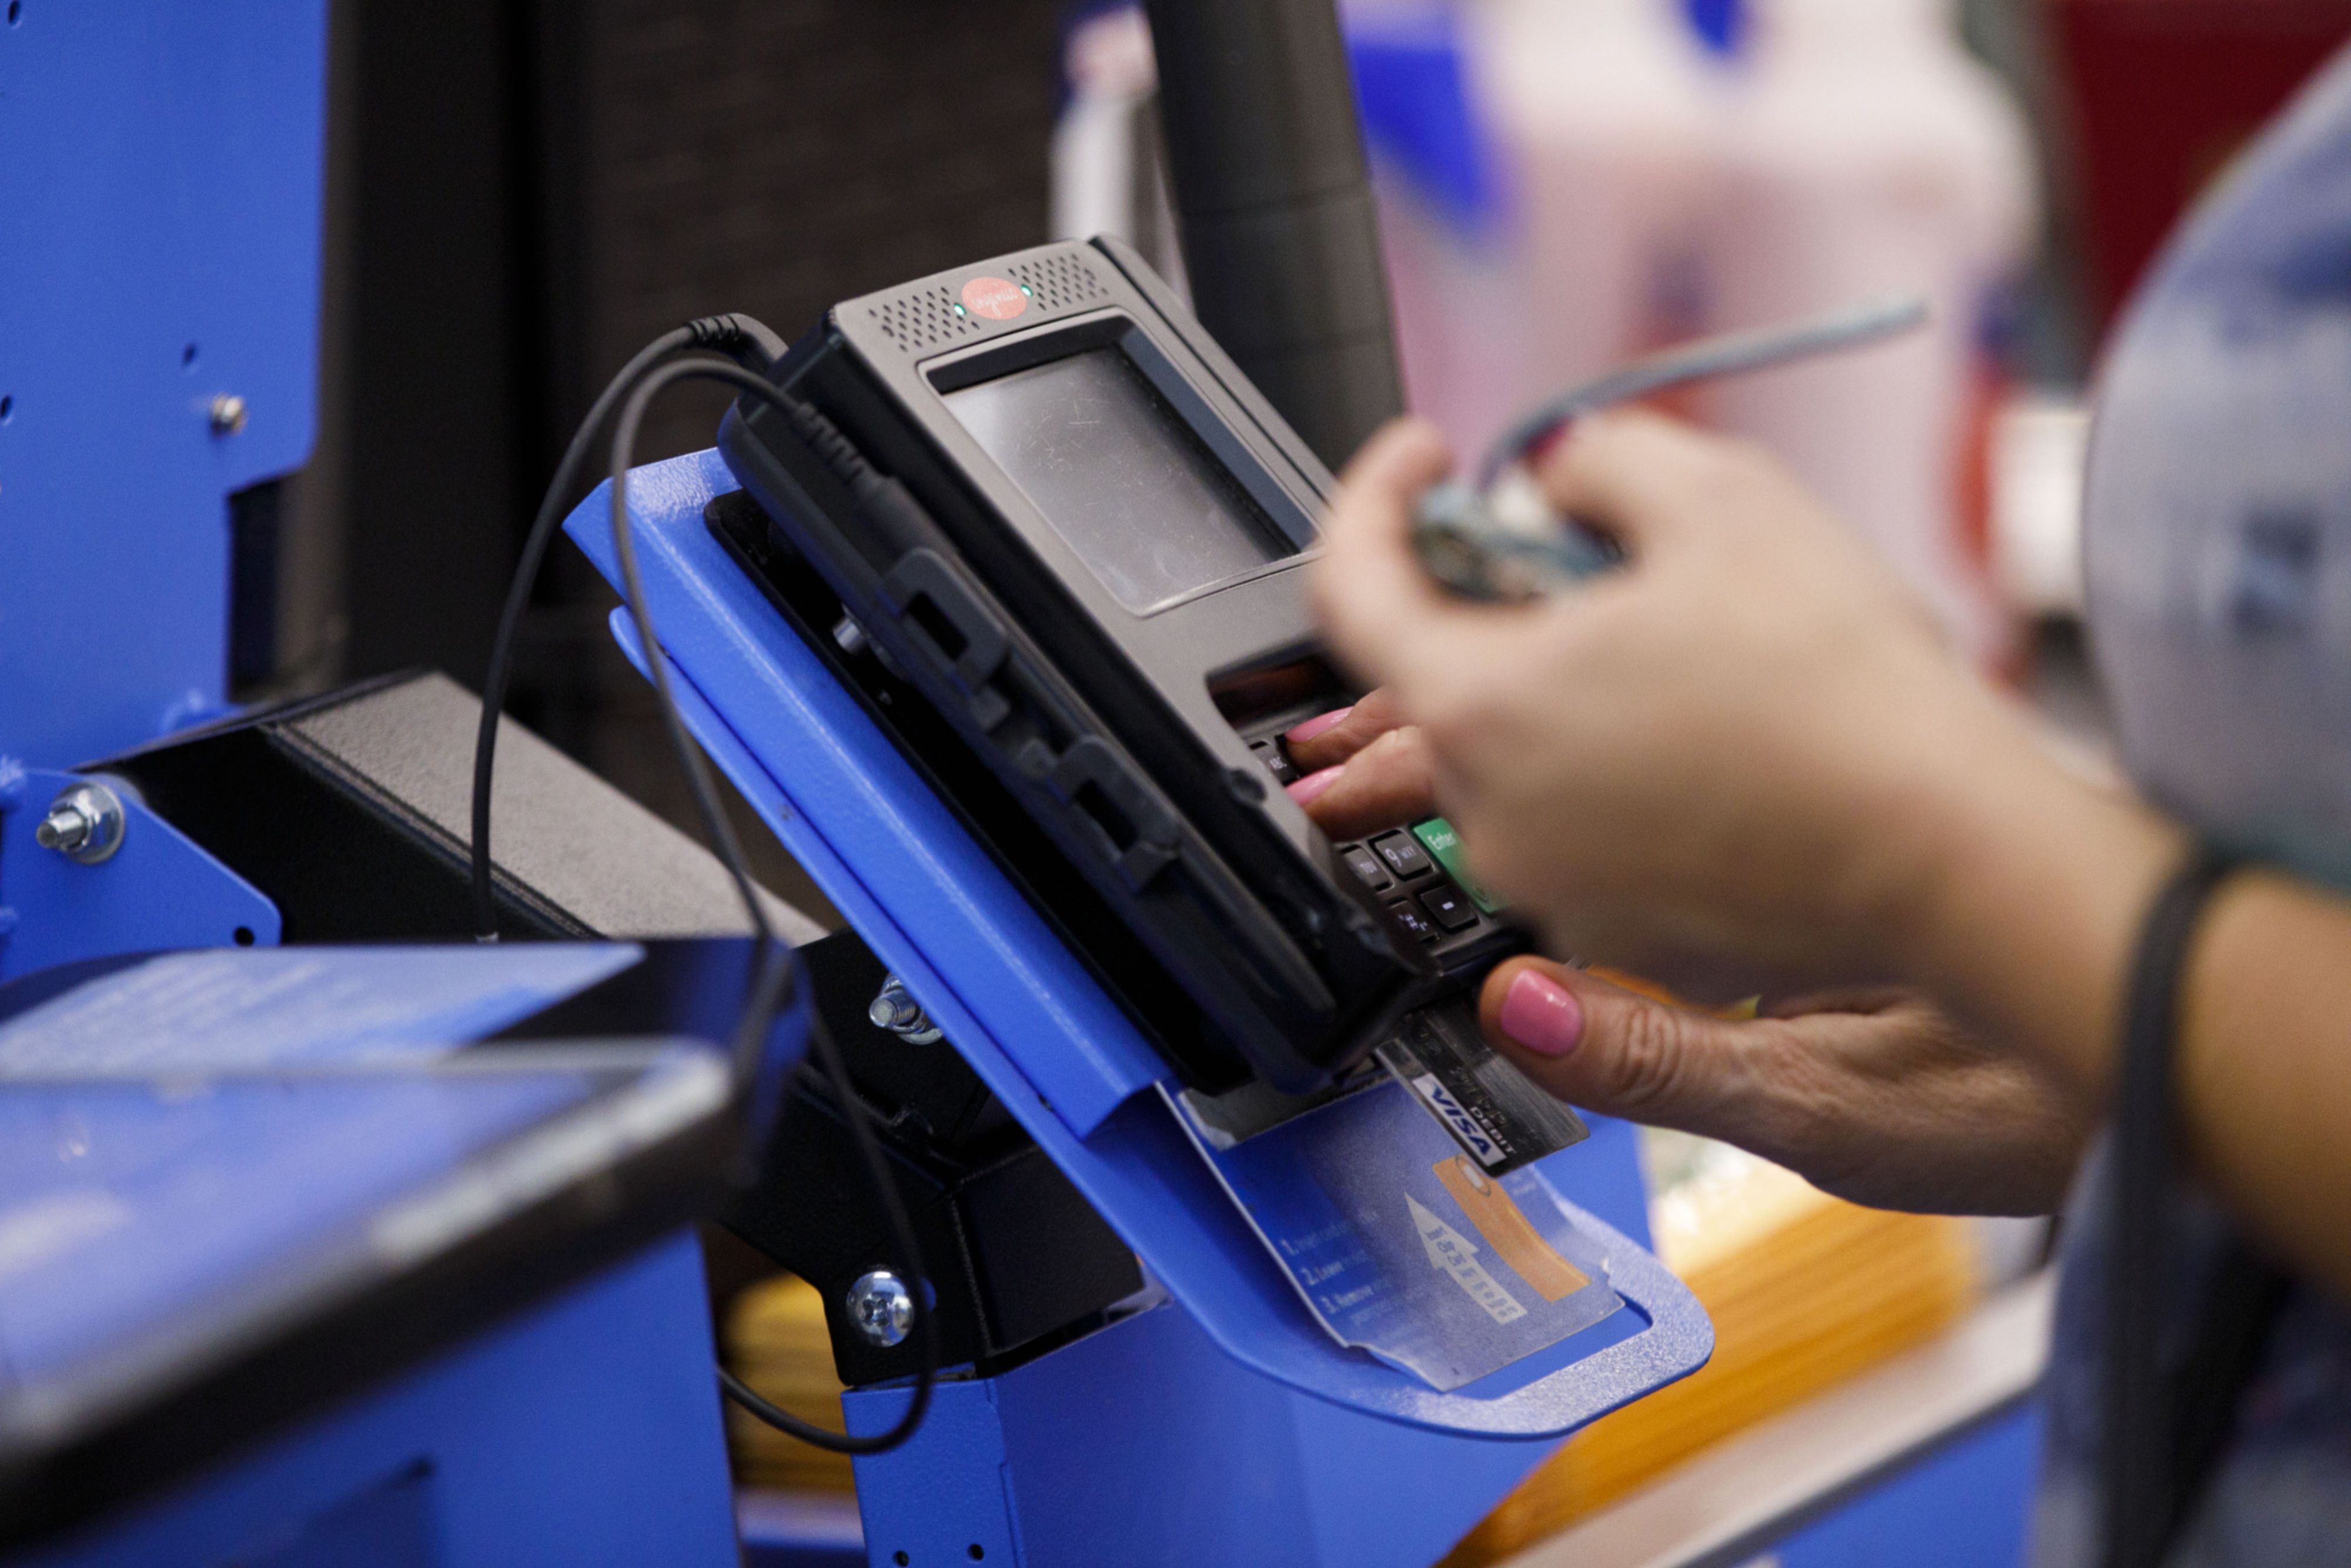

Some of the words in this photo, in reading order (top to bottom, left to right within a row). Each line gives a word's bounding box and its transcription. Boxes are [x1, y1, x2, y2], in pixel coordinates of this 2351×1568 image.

[1385, 848, 1402, 867] 9
[1431, 1083, 1492, 1156] VISA
[1470, 1106, 1517, 1154] DEBIT
